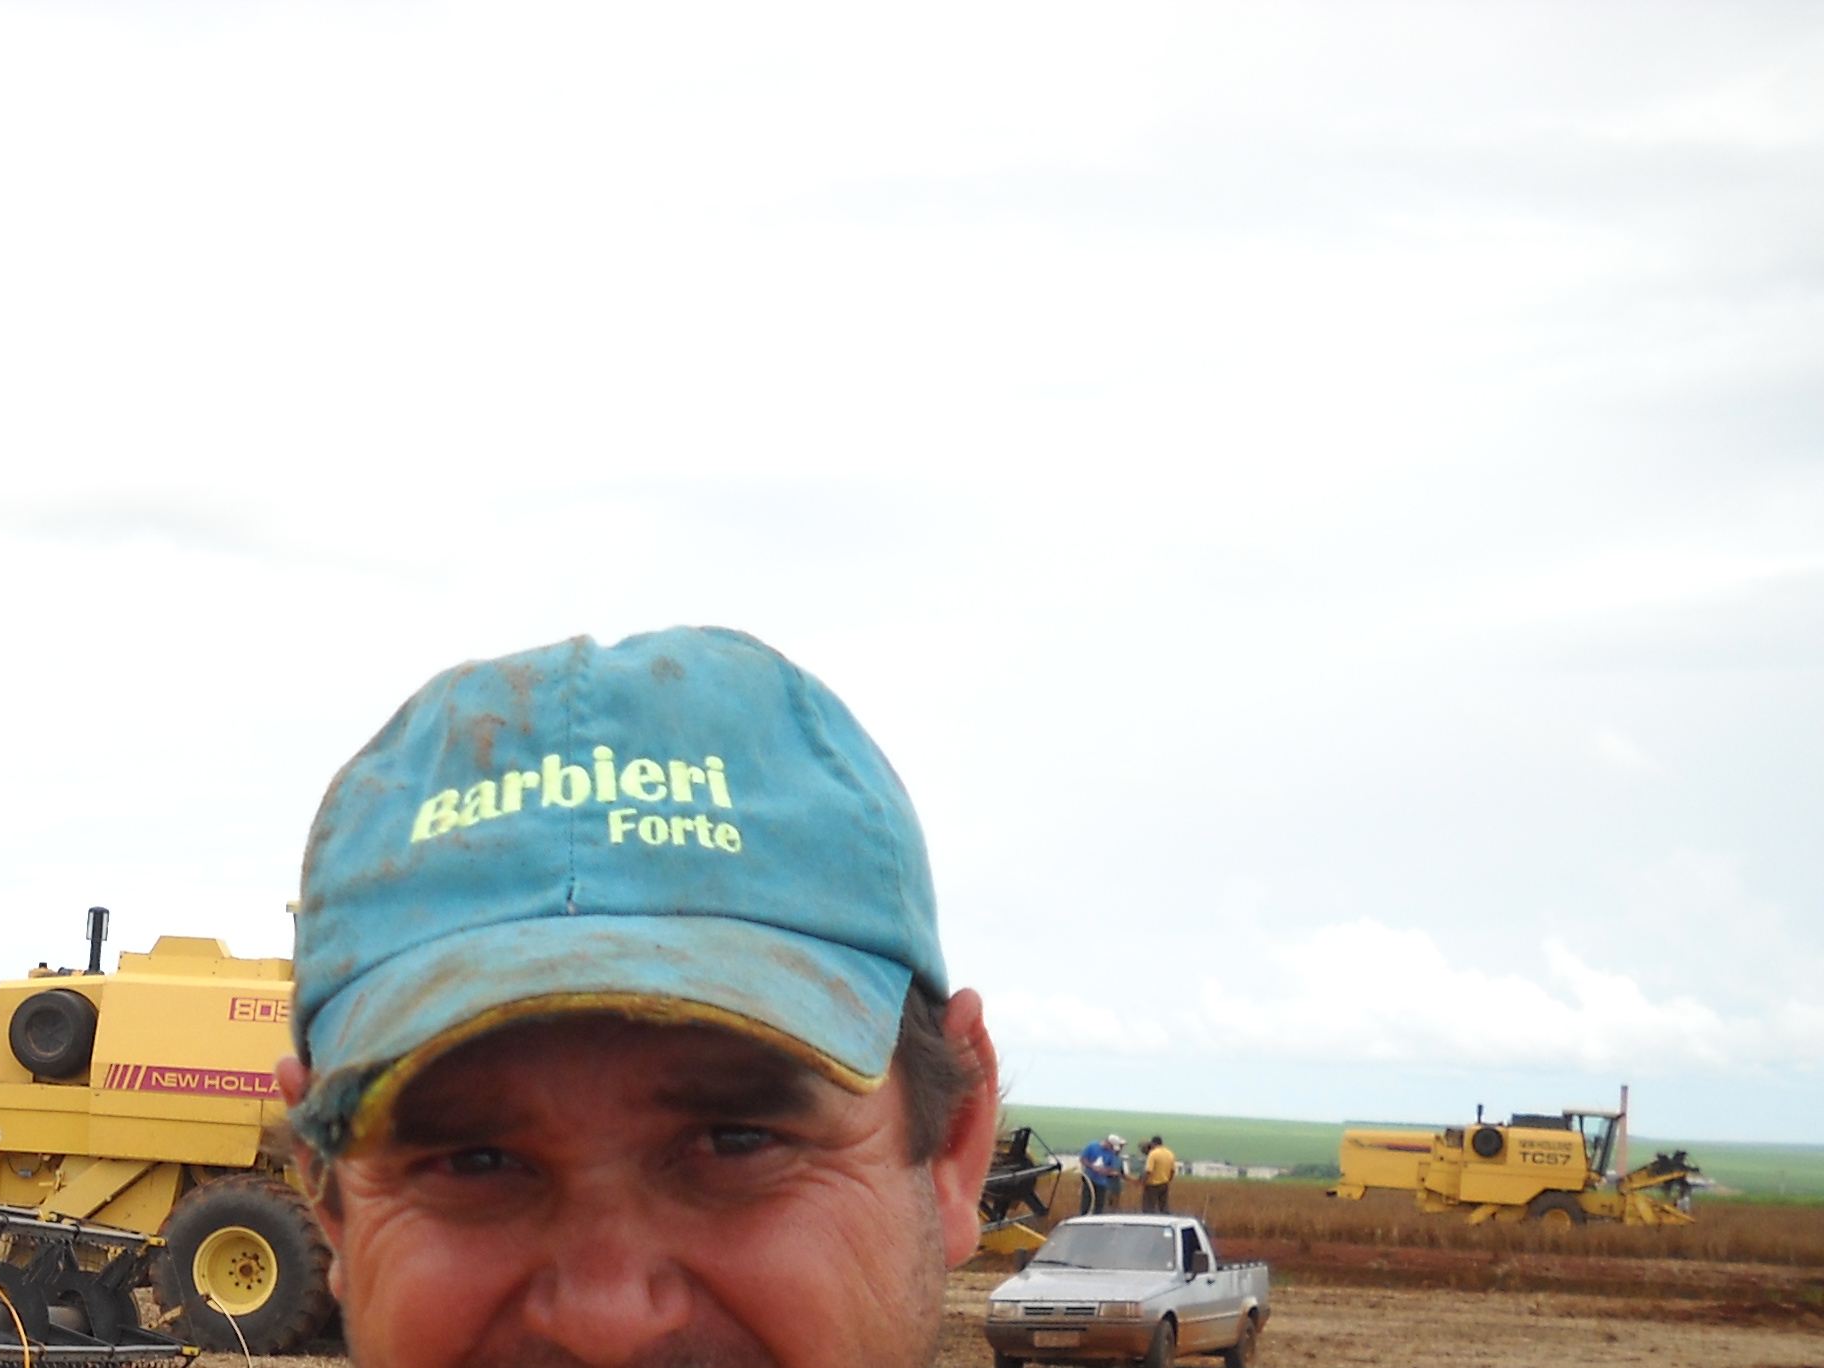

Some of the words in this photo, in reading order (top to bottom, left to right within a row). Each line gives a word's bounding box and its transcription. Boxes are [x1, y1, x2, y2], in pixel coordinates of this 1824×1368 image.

[410, 745, 733, 843] Barbieri
[608, 807, 742, 852] Forte
[234, 998, 291, 1022] 805
[151, 1071, 200, 1088] NEW
[204, 1075, 281, 1093] HOLLA
[1519, 1151, 1571, 1165] TC57
